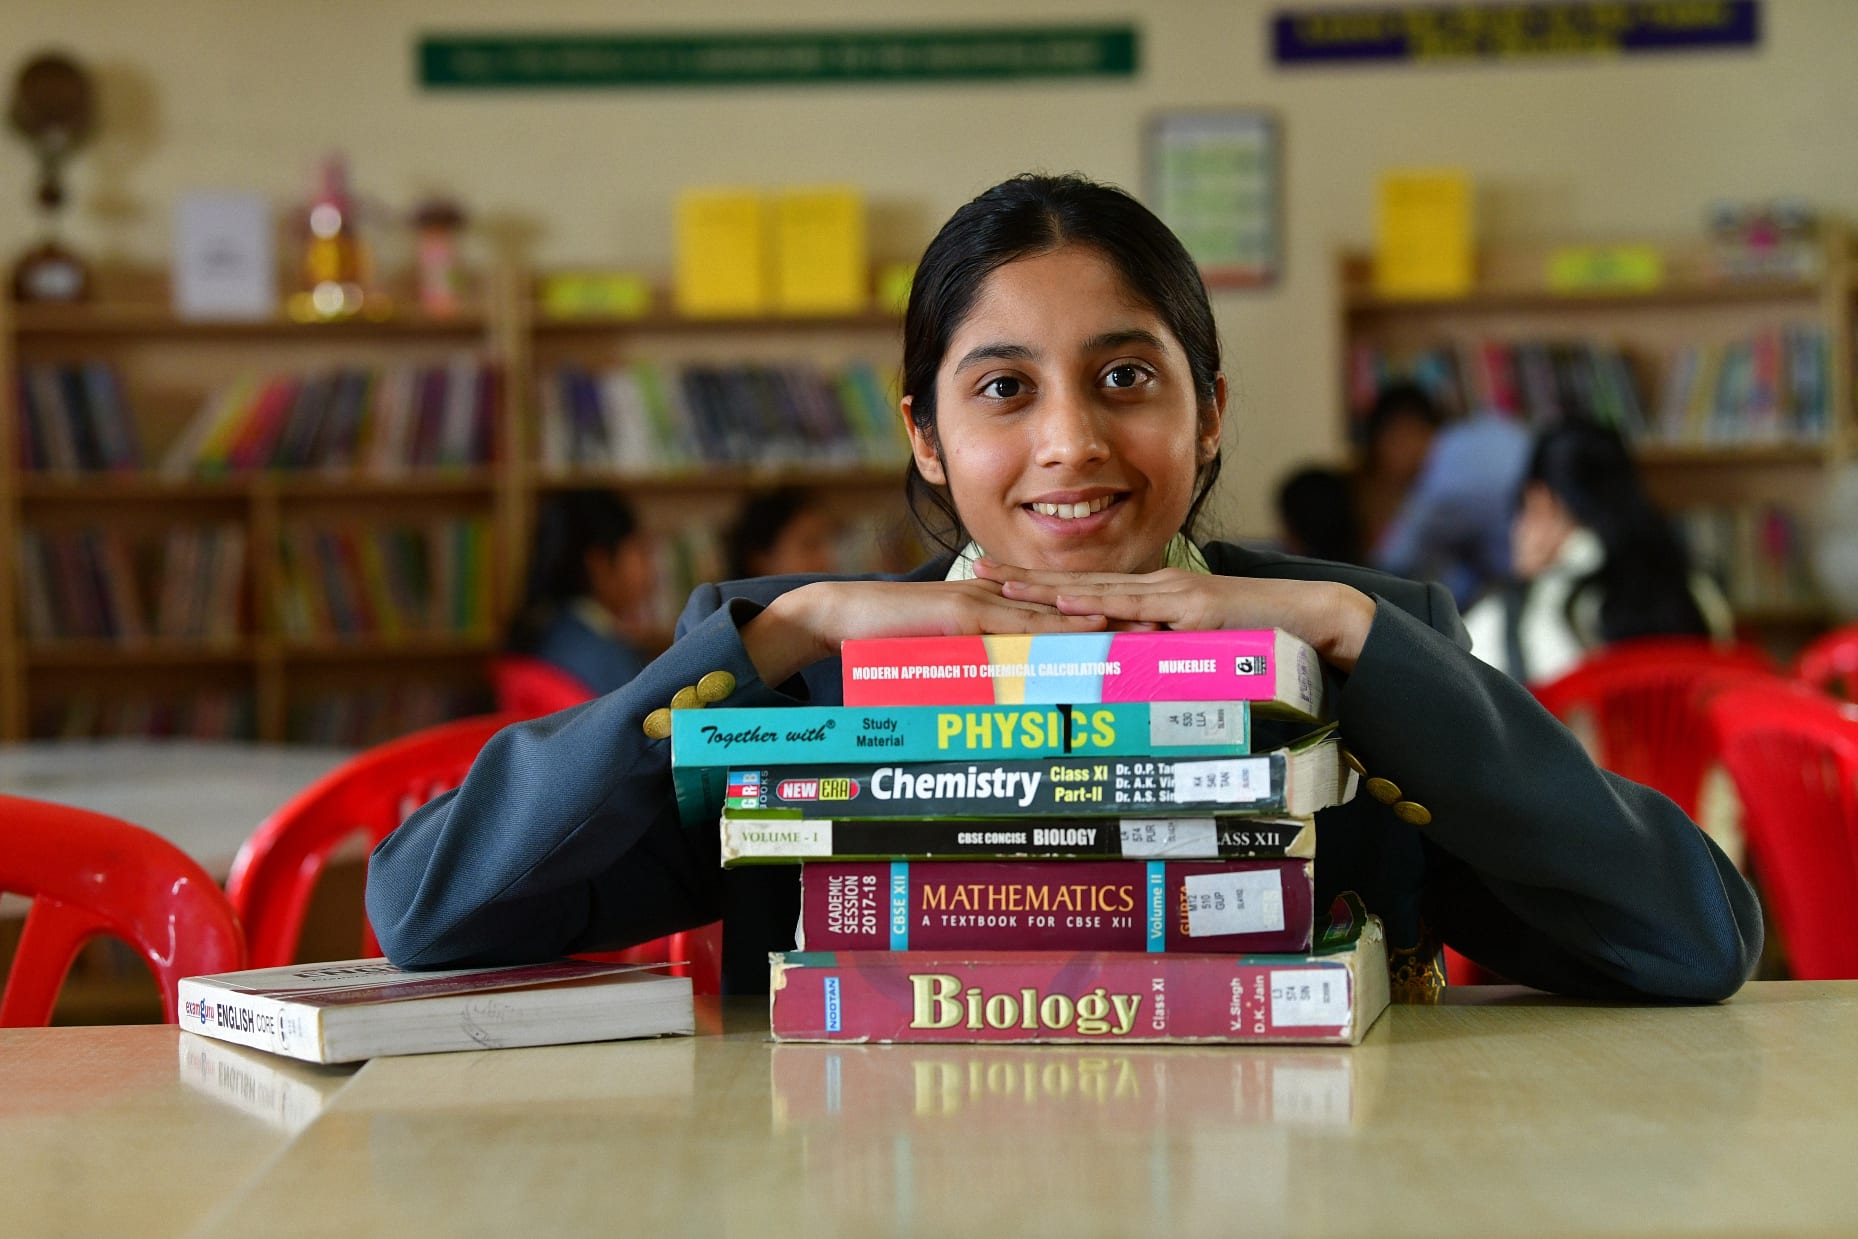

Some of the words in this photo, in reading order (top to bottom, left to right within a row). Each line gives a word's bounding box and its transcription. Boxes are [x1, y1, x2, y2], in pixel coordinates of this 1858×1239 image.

[852, 666, 899, 680] MODERN
[901, 665, 960, 679] APPROACH
[962, 664, 977, 678] TO
[980, 663, 1036, 678] CHEMICAL
[1038, 661, 1121, 677] CALCULATIONS
[1158, 659, 1216, 674] MUKERJEE
[862, 718, 898, 732] Study
[937, 710, 1116, 750] PHYSICS
[701, 724, 778, 749] Together
[856, 734, 905, 748] Material
[1050, 766, 1090, 782] Class
[1093, 765, 1108, 781] XI
[1116, 763, 1131, 776] Dr.
[1133, 763, 1155, 775] O.P.
[742, 773, 758, 809] GRB
[783, 782, 817, 798] NEW
[821, 778, 848, 798] ERA
[870, 766, 1042, 807] Chemistry
[1115, 777, 1131, 789] Dr.
[1133, 777, 1156, 789] A.K.
[1055, 786, 1103, 802] Part-II
[1115, 791, 1131, 803] Dr.
[1133, 791, 1156, 803] A.S.
[742, 832, 800, 843] VOLUME
[957, 832, 984, 845] CBSE
[984, 832, 1027, 845] CONCISE
[1033, 828, 1097, 846] BIOLOGY
[1217, 832, 1250, 846] ASS
[1254, 832, 1280, 846] XII
[893, 874, 906, 895] XII
[1151, 874, 1162, 884] II
[828, 875, 843, 934] ACADEMIC
[844, 875, 858, 934] SESSION
[862, 875, 877, 935] 2017-18
[921, 884, 1135, 912] MATHEMATICS
[1214, 892, 1226, 911] GUP
[893, 897, 906, 935] CBSE
[922, 915, 931, 927] A
[941, 915, 1017, 927] TEXTBOOK
[1028, 916, 1056, 928] FOR
[1066, 916, 1101, 928] CBSE
[1112, 916, 1133, 928] XII
[1151, 887, 1163, 939] Volume
[1152, 977, 1165, 993] XI
[1254, 975, 1265, 1003] Jain
[828, 979, 837, 1030] NOOTAN
[908, 973, 1142, 1036] Biology
[1152, 994, 1165, 1030] Class
[217, 1003, 255, 1033] ENGLISH
[256, 1013, 275, 1035] CORE
[1254, 1007, 1265, 1033] D.K.
